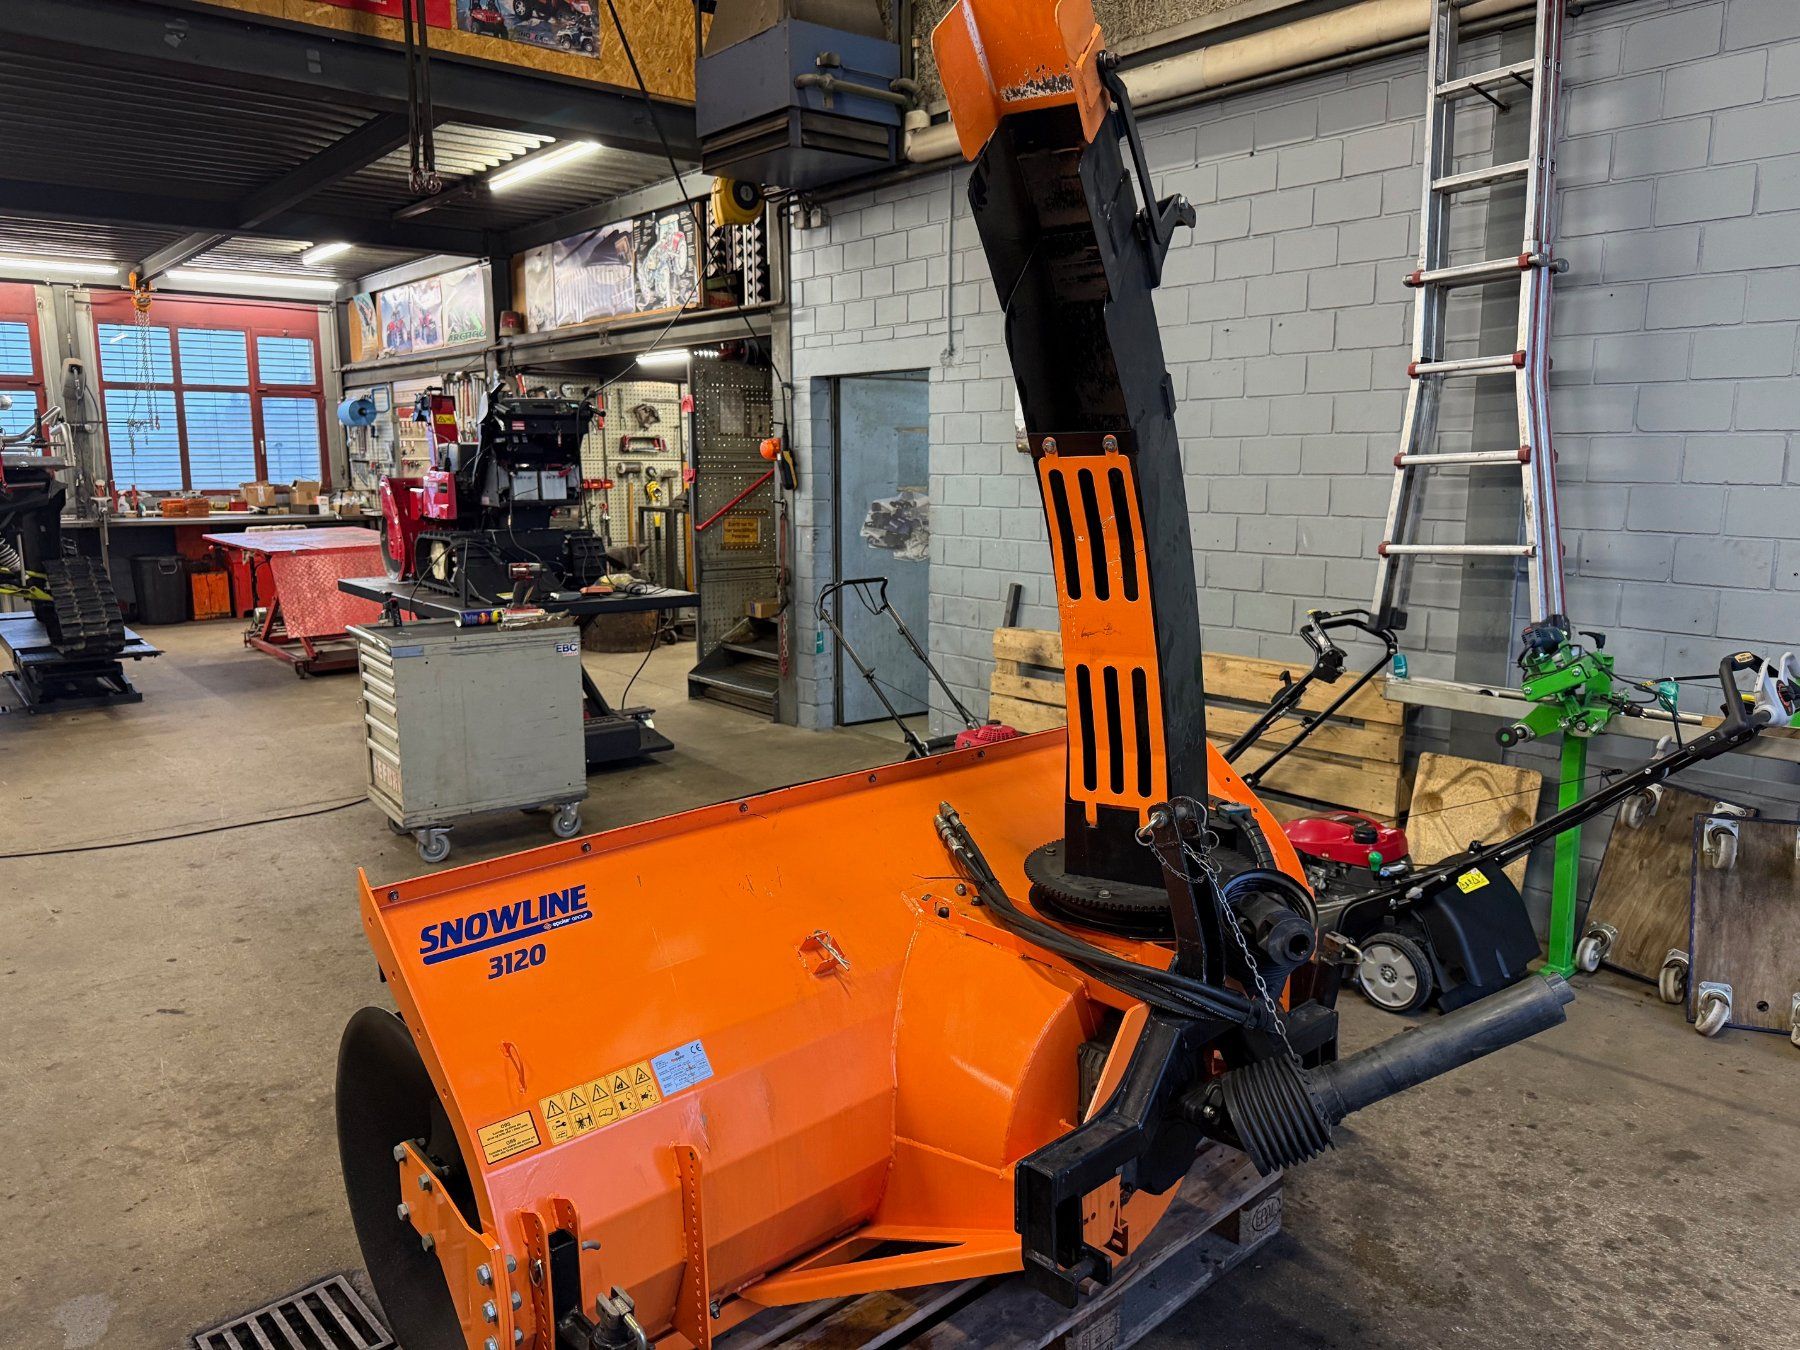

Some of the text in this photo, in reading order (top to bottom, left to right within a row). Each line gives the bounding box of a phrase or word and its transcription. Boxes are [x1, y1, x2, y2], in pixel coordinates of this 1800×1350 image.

[556, 644, 578, 653] EBC
[420, 884, 588, 954] SNOWLINE
[488, 943, 547, 979] 3120
